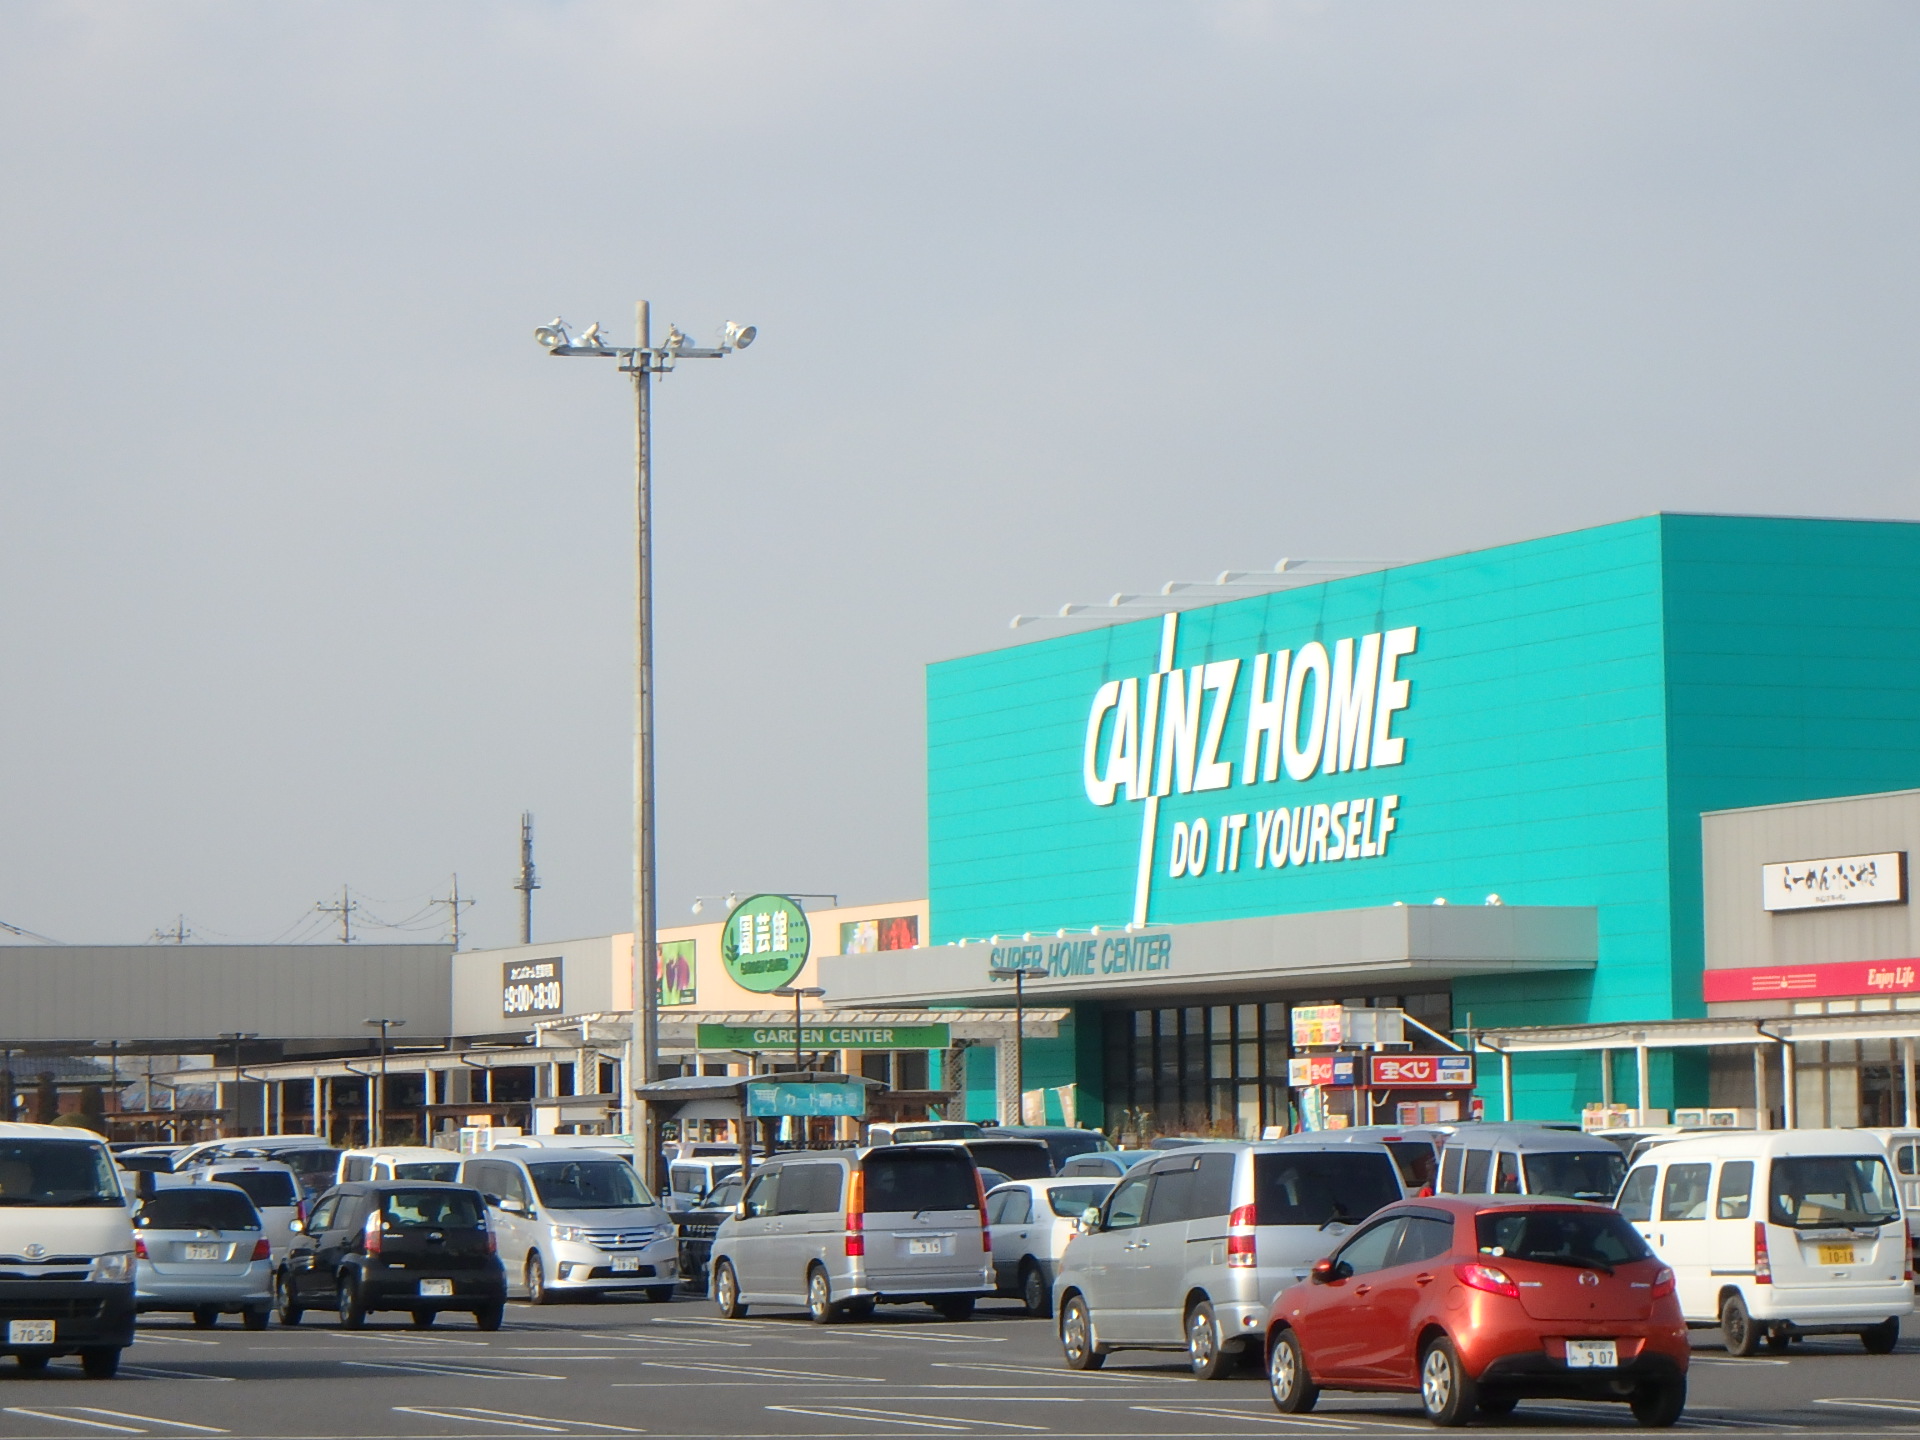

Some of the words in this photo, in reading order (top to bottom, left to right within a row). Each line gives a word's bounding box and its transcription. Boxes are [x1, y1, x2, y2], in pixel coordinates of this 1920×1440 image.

[1083, 658, 1240, 806] CAINZ
[1241, 626, 1418, 785] HOME
[1169, 817, 1209, 878] DO
[1216, 813, 1248, 872] IT
[1255, 794, 1399, 869] YOURSELF
[739, 910, 788, 955] 園芸館
[1048, 940, 1098, 977] HOME
[1102, 934, 1172, 974] CENTER
[1868, 968, 1894, 989] Enjoy
[1896, 966, 1915, 988] Life
[753, 1029, 824, 1044] GARDEN
[829, 1029, 894, 1043] CENTER
[1380, 1061, 1430, 1080] 宝くじ
